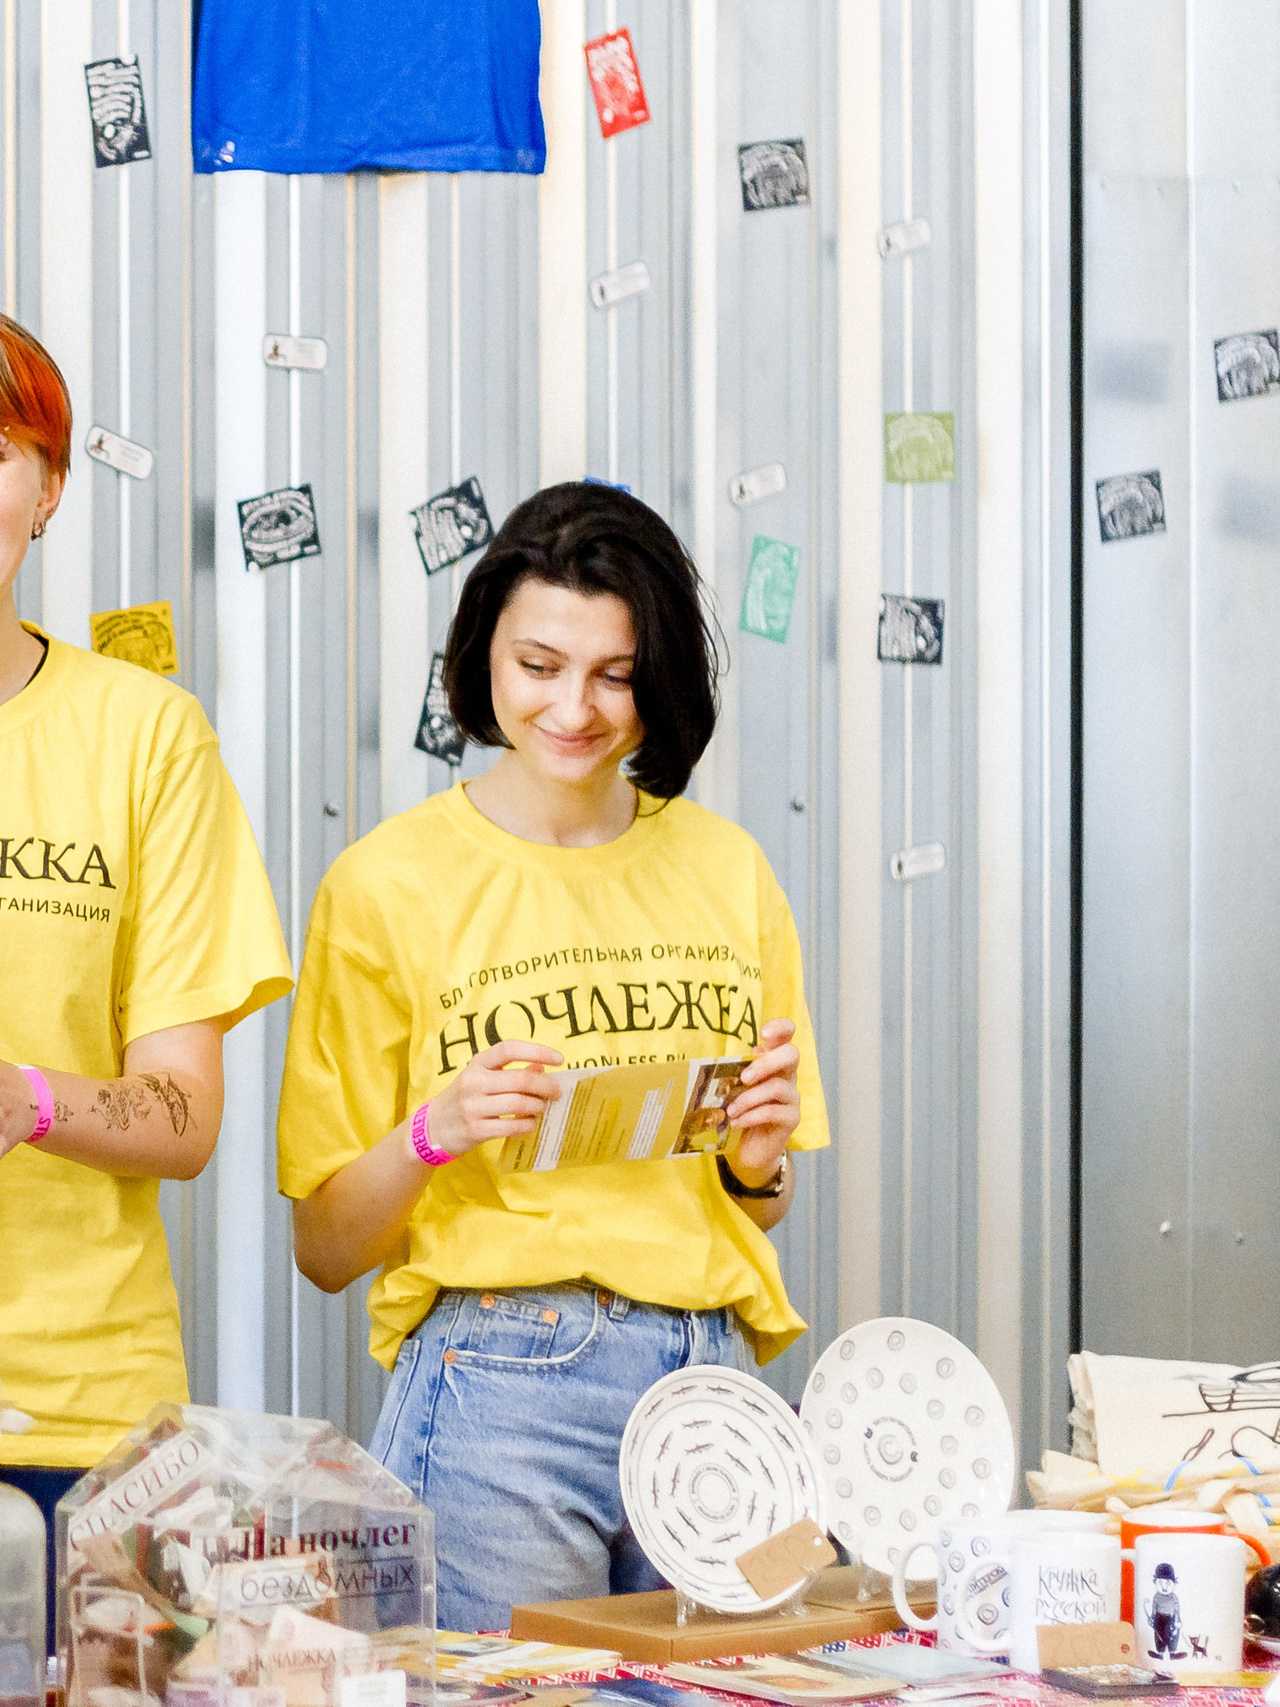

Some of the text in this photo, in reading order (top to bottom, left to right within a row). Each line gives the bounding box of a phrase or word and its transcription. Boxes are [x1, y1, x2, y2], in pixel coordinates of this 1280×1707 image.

[438, 946, 643, 1010] БЛГОТВОРИТЕЛЬНАЯ
[437, 979, 759, 1076] НОЧЛЕЖКА
[69, 1436, 200, 1552] СПАСИБО
[298, 1521, 417, 1553] ночлег
[239, 1562, 417, 1602] бездомных
